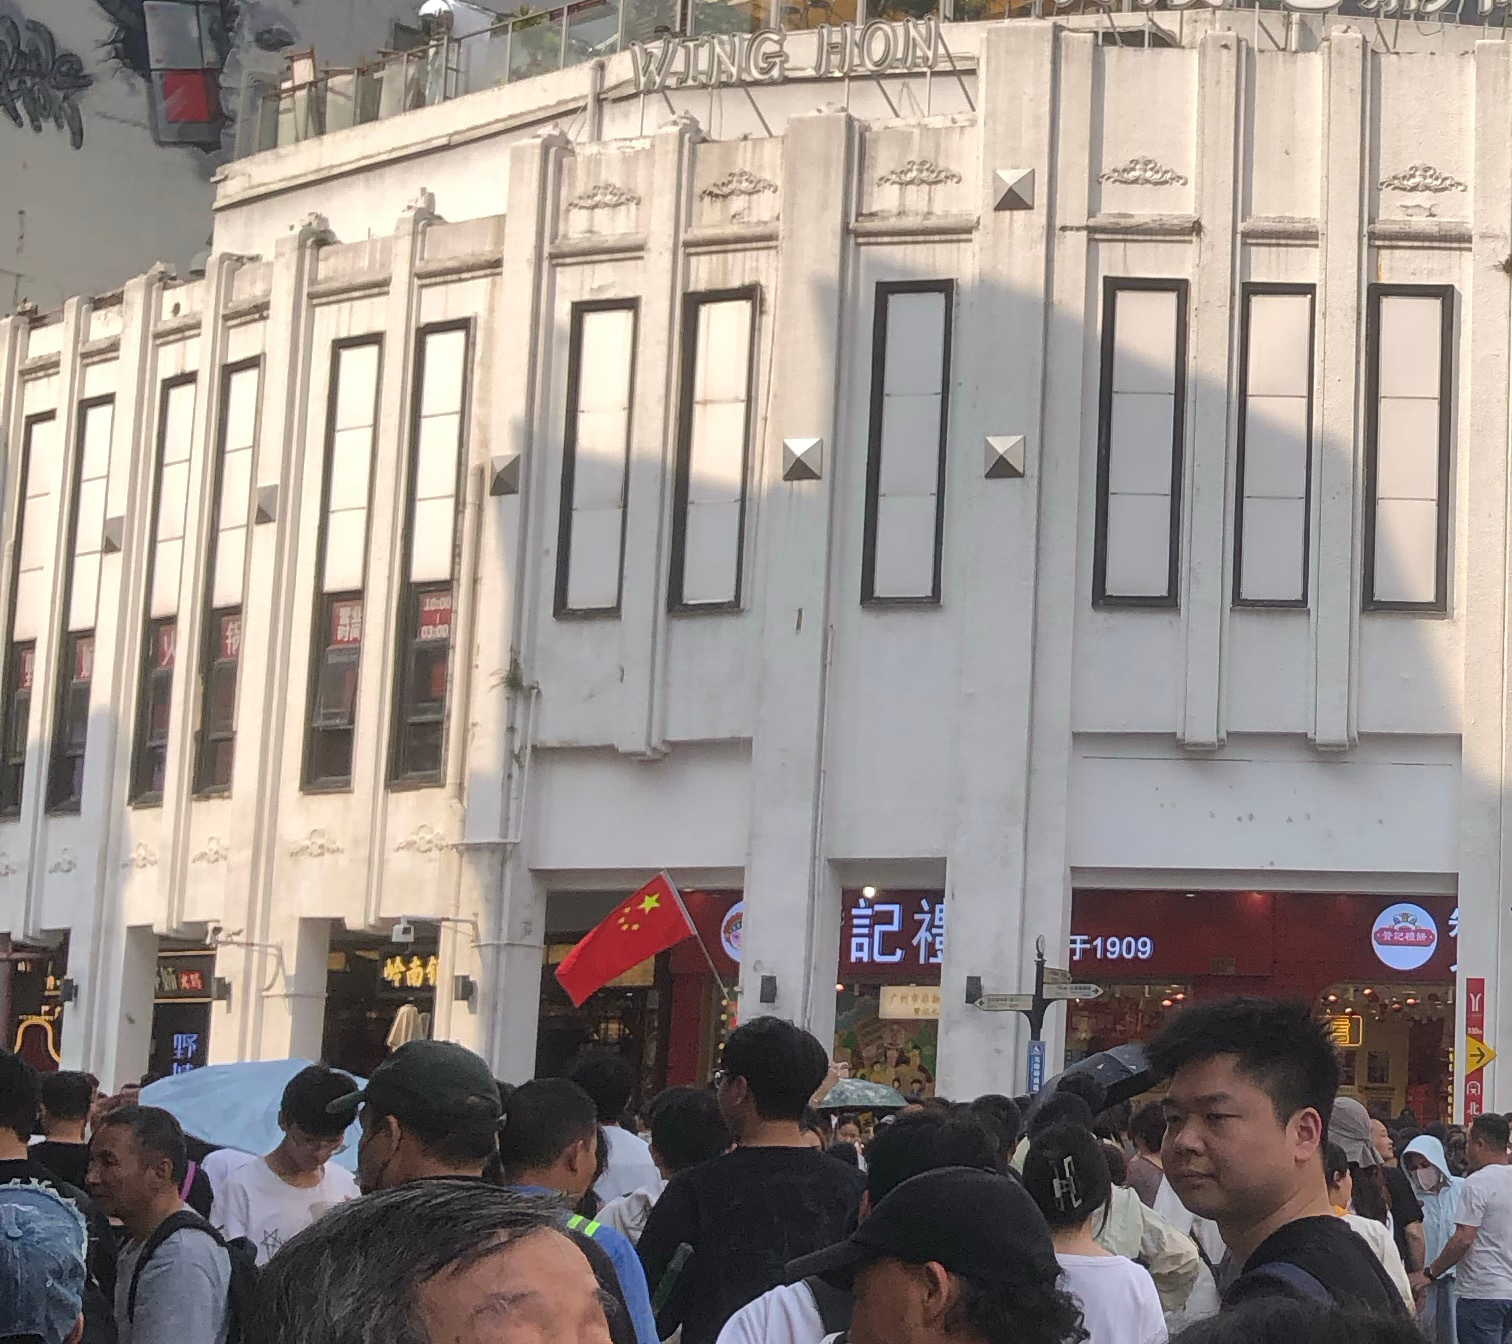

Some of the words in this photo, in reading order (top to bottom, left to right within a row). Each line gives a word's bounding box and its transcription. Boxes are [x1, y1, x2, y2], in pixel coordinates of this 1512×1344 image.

[631, 29, 787, 93] WING
[816, 15, 941, 78] HON
[420, 624, 449, 639] 03:00
